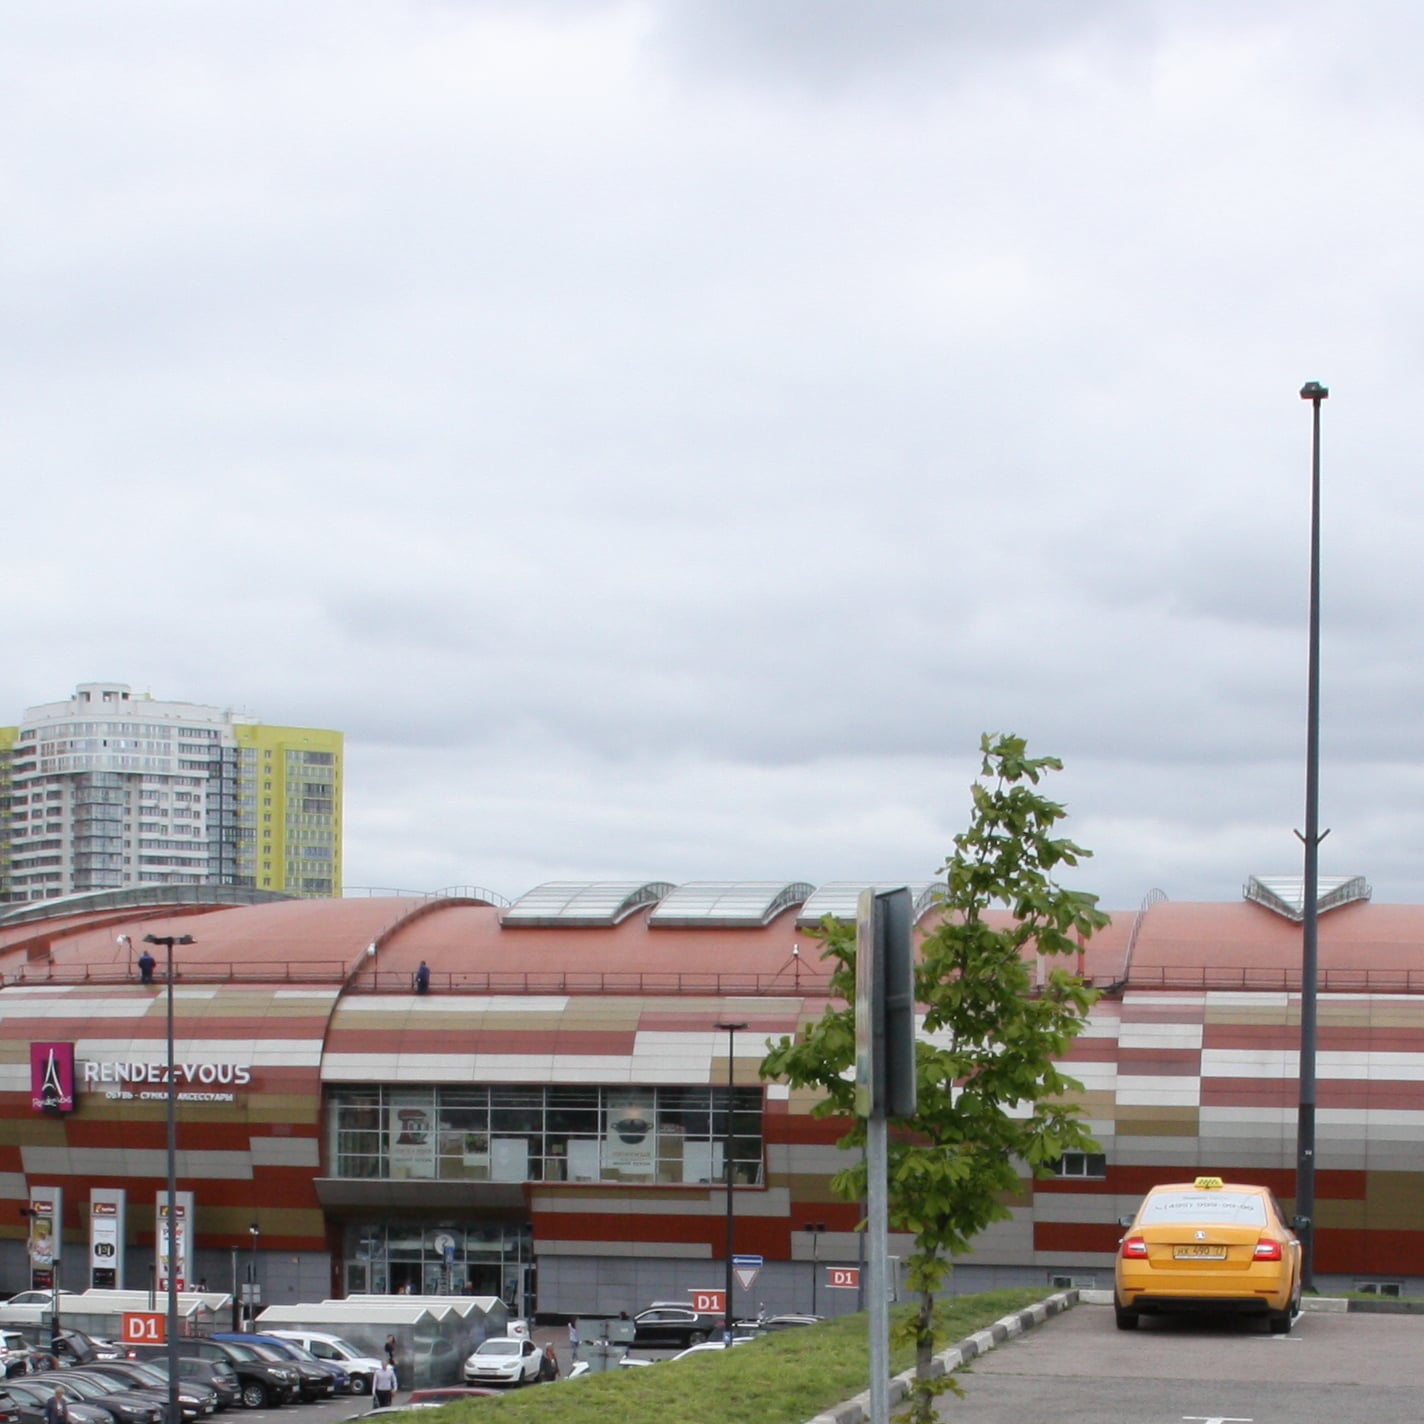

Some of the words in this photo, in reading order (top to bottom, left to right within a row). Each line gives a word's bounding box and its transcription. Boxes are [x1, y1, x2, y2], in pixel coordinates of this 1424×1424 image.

[834, 1272, 853, 1284] D1
[697, 1295, 720, 1310] D1
[129, 1317, 159, 1339] D1
